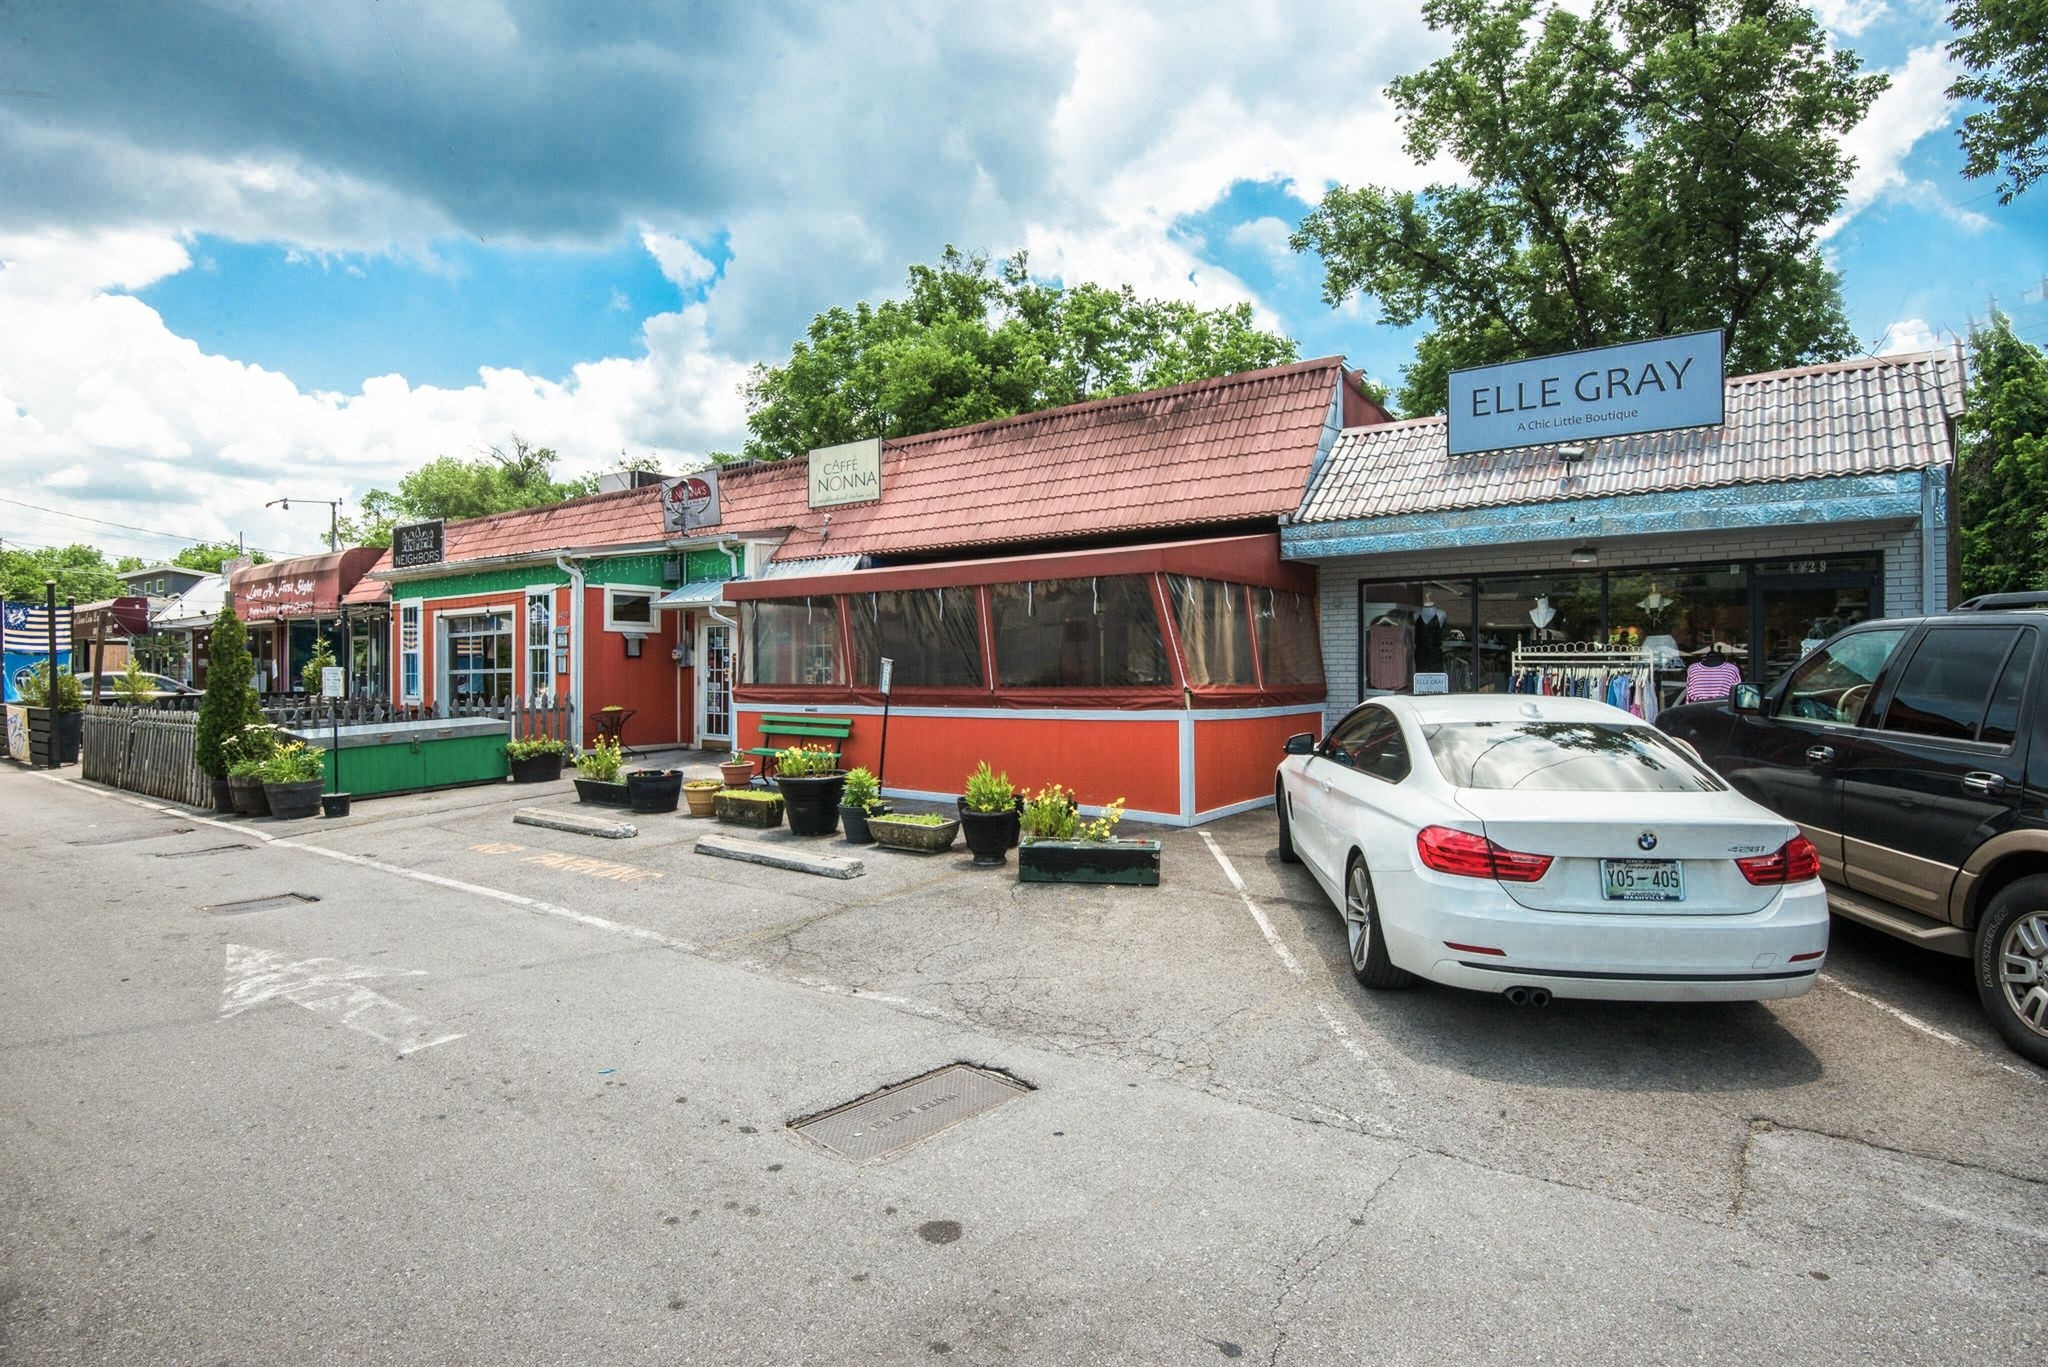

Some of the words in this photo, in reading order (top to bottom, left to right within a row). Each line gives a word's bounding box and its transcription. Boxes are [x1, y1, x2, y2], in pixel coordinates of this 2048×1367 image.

[1472, 376, 1562, 417] ELLE
[1574, 357, 1694, 401] GRAY
[1517, 422, 1528, 432] A
[1528, 418, 1551, 430] Chic
[1554, 415, 1582, 428] Little
[1586, 407, 1639, 423] Boutique
[818, 470, 878, 493] NONNA
[395, 550, 440, 566] NEIGHBORS
[1982, 905, 2009, 988] MICHELIN
